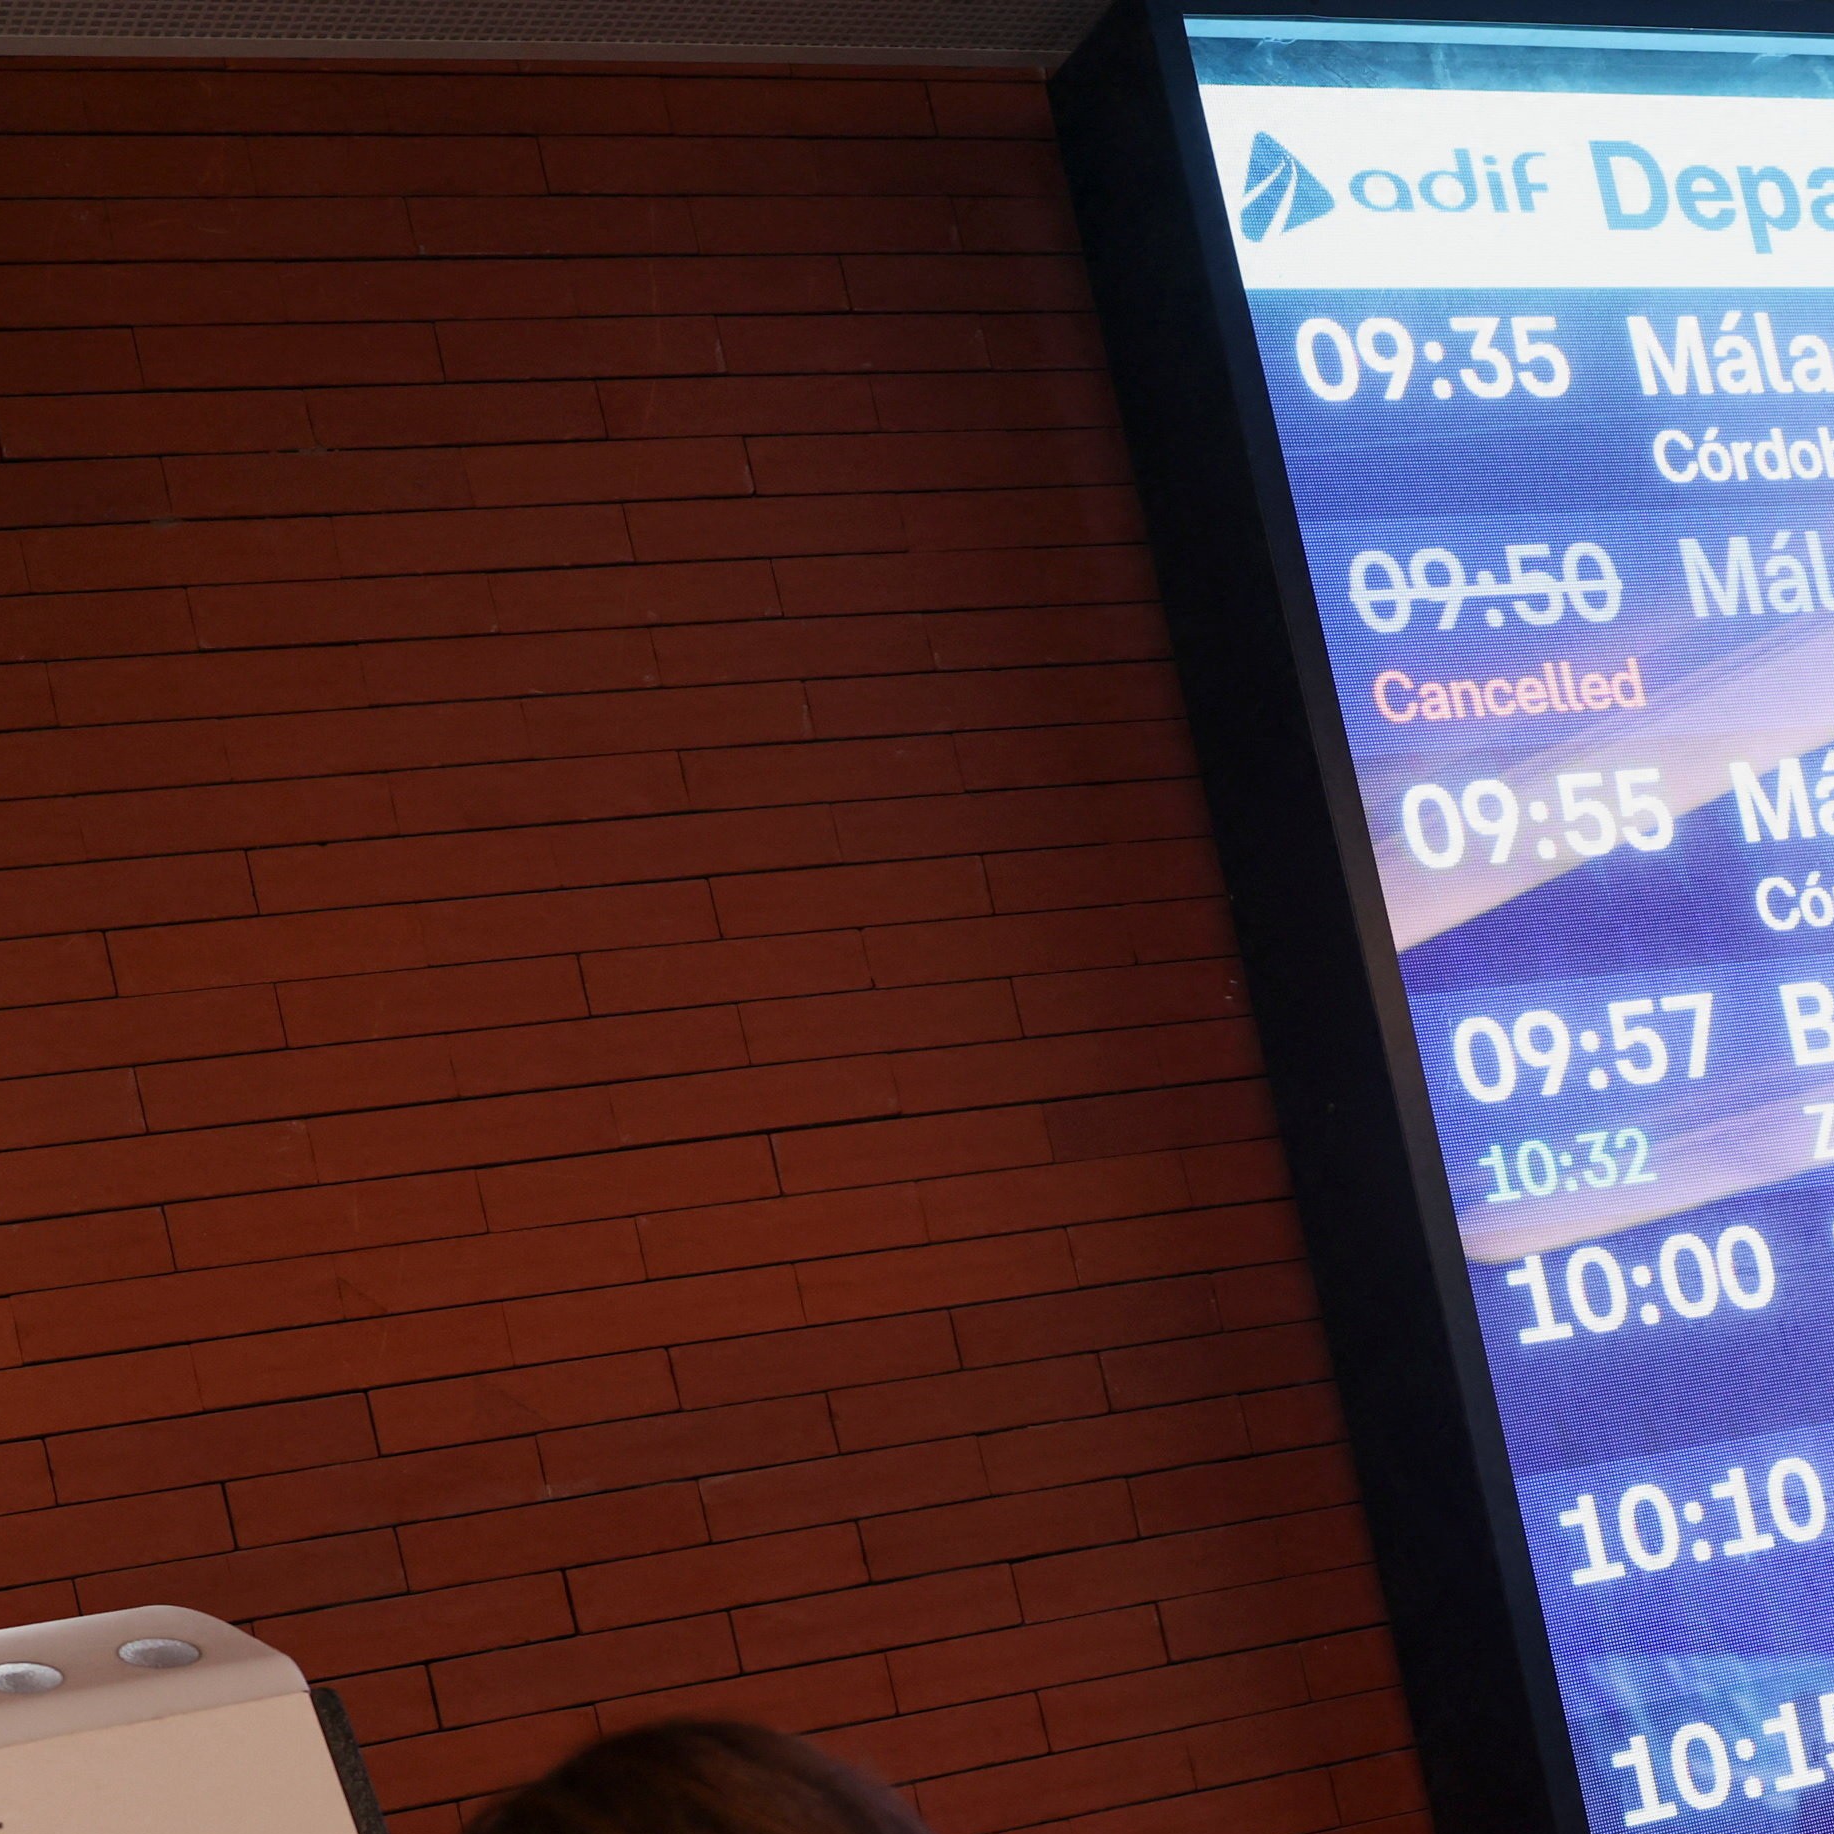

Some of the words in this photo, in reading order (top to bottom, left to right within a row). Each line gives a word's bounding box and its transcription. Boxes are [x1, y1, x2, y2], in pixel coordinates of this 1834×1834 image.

[1348, 148, 1550, 213] adif
[1296, 314, 1571, 405] 09:35
[1349, 541, 1623, 634] 09:50
[1372, 658, 1647, 726] Cancelled
[1401, 769, 1675, 871] 09:55
[1453, 992, 1715, 1105] 09:57
[1479, 1127, 1657, 1203] 10:32
[1507, 1224, 1776, 1346] 10:00
[1559, 1457, 1827, 1588] 10:10
